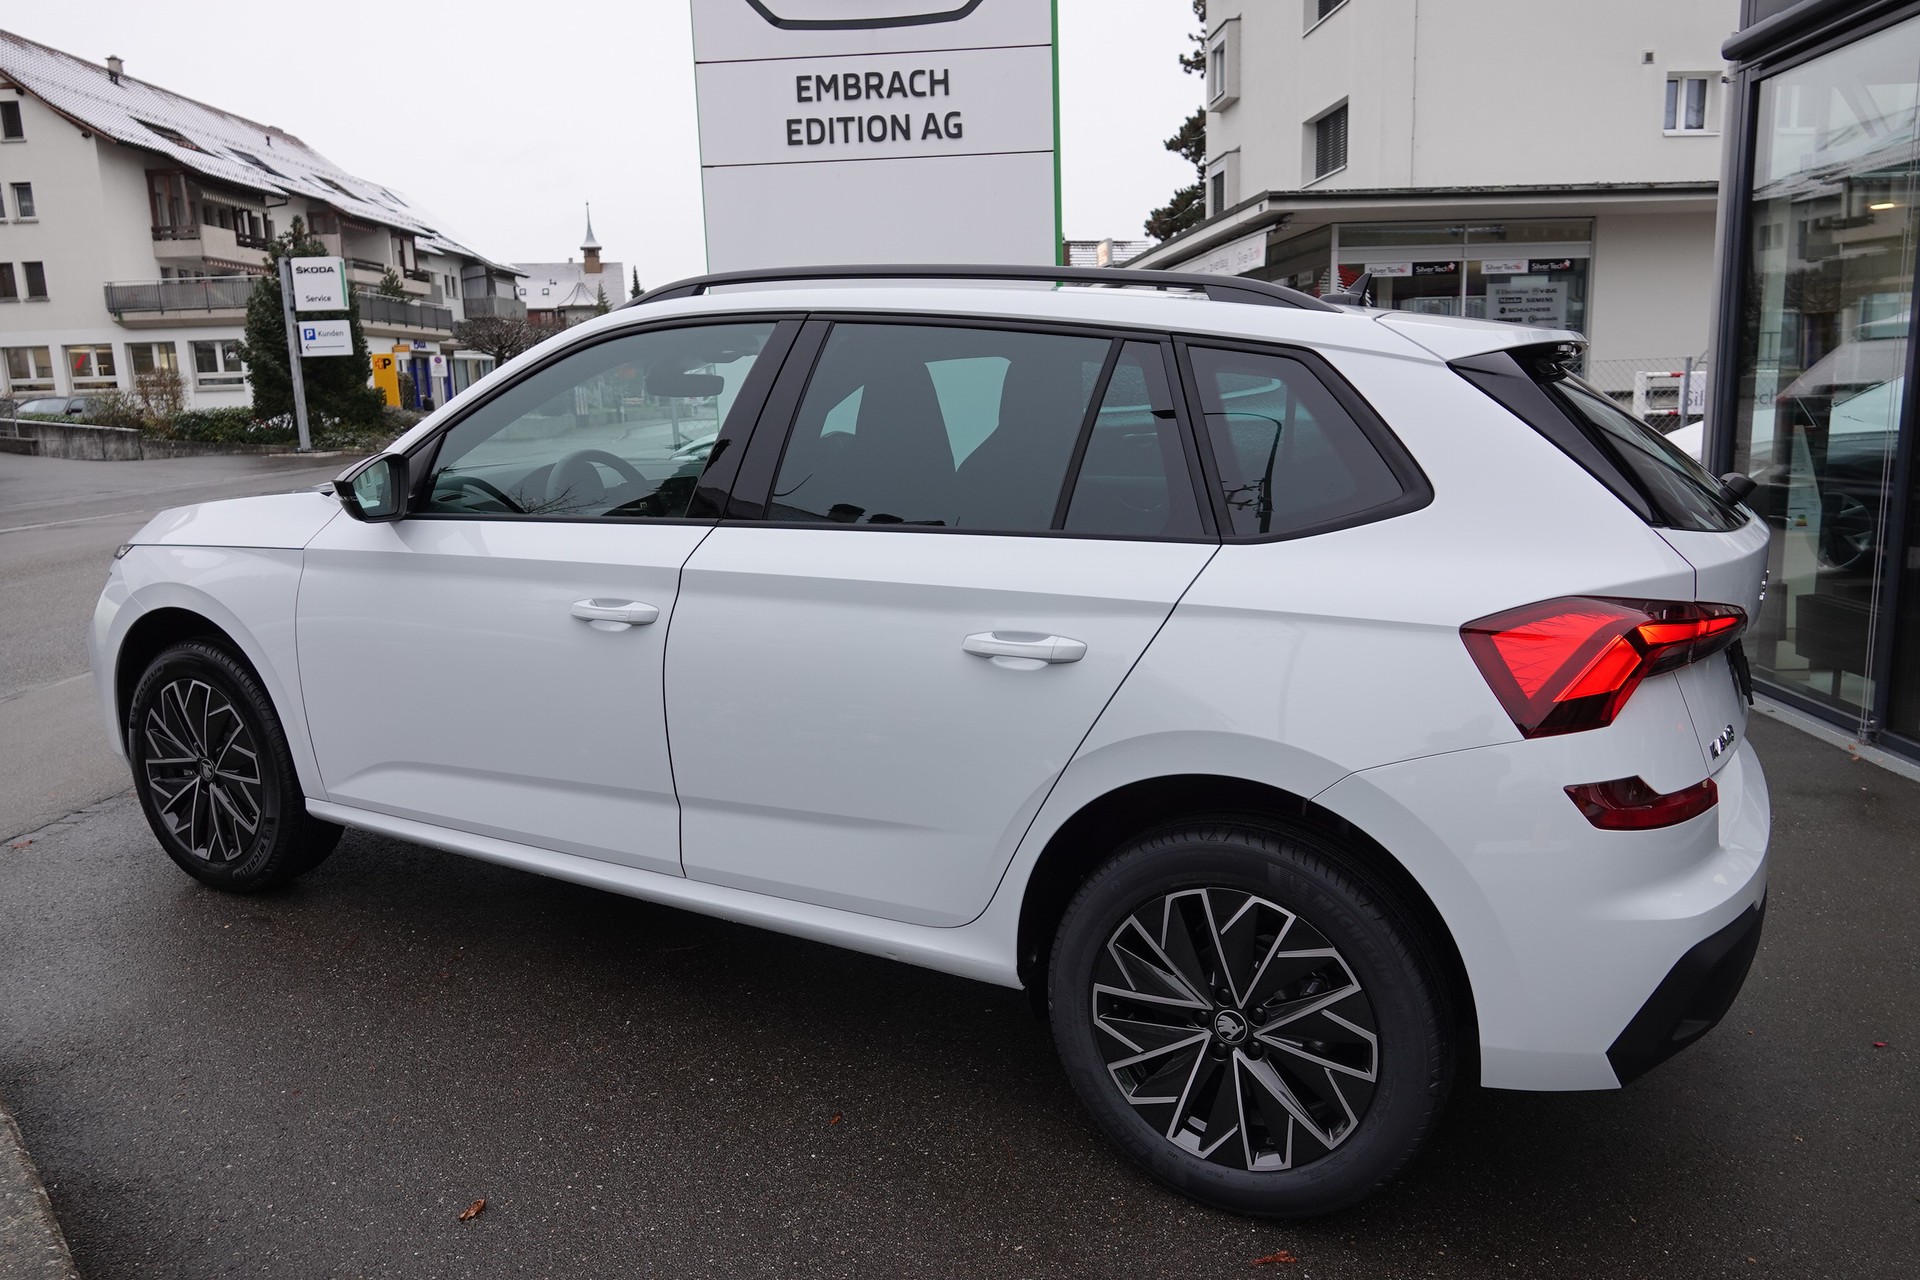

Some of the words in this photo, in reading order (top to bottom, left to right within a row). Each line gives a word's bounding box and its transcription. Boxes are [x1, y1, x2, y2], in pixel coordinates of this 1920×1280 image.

[796, 68, 950, 103] EMBRACH
[786, 113, 911, 146] EDITION
[921, 111, 963, 140] AG
[306, 294, 332, 303] Service
[318, 329, 344, 337] Kunden
